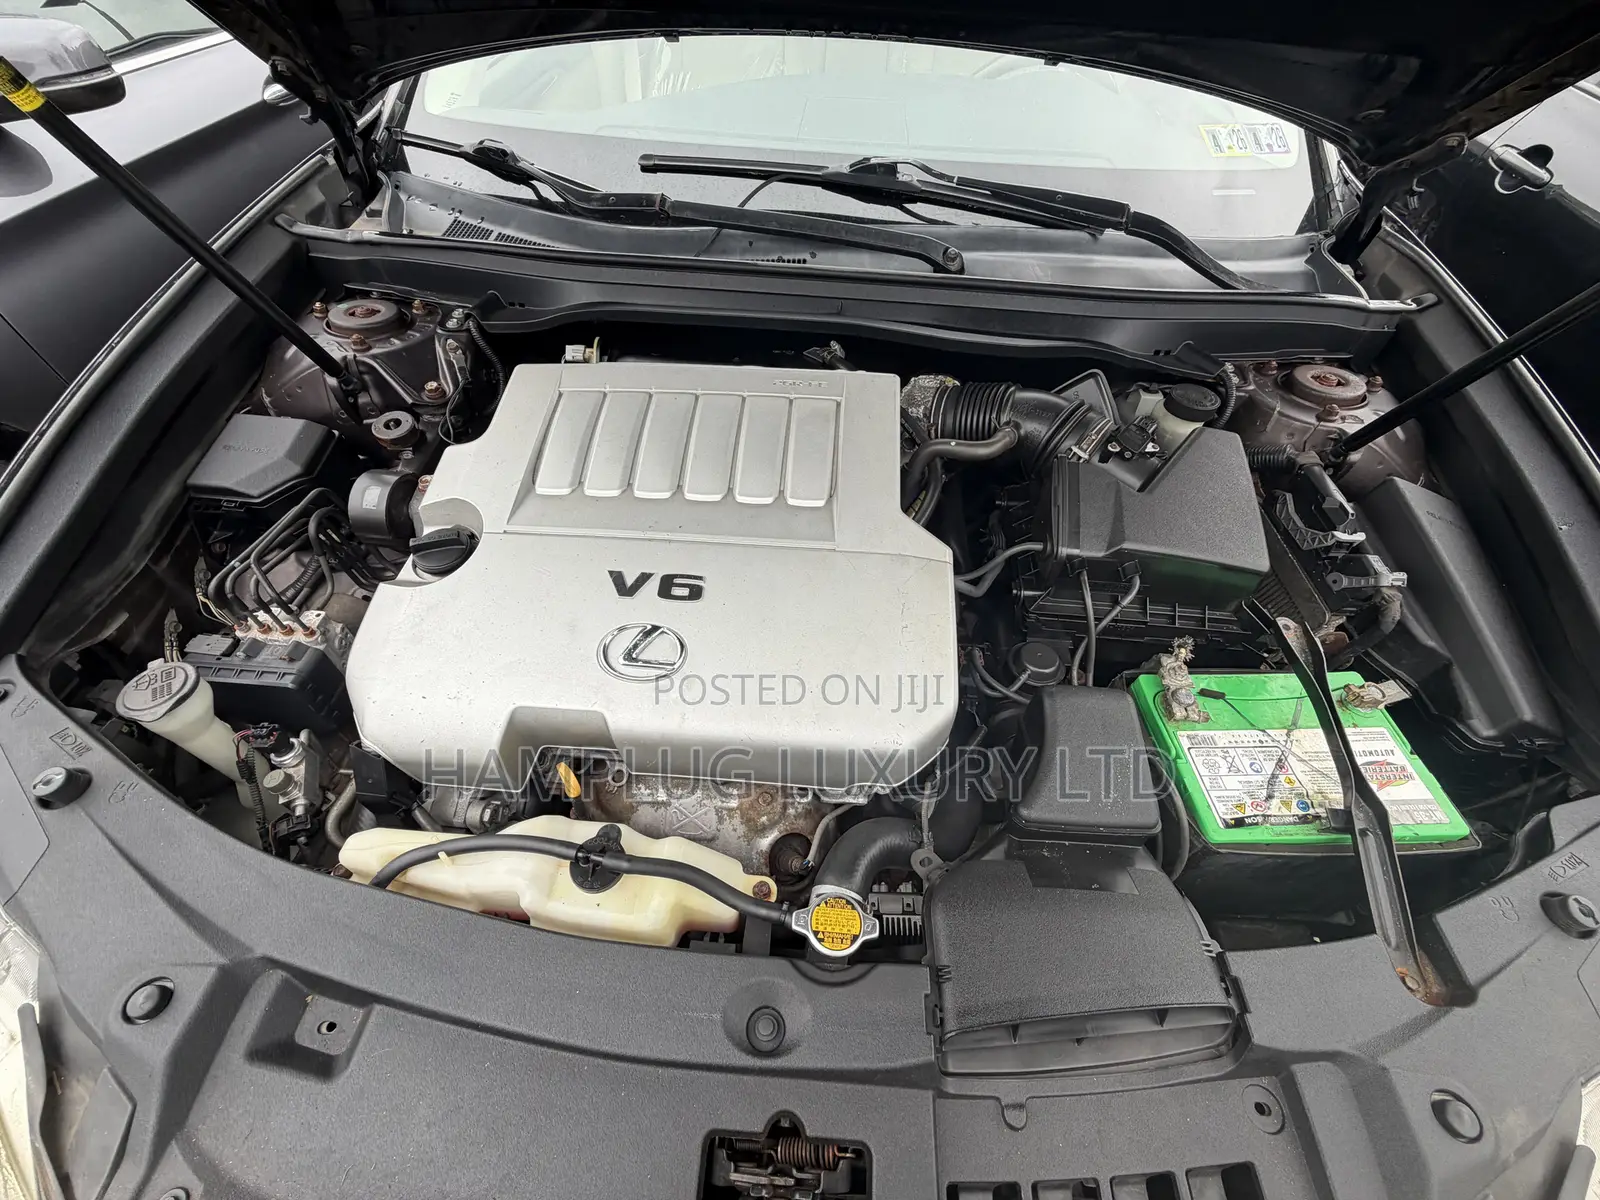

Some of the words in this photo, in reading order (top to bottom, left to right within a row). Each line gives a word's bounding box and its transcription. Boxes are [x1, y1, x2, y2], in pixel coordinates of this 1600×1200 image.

[608, 570, 706, 601] V6
[1353, 749, 1395, 758] AUTOMOTI
[1360, 765, 1406, 773] BATTERIE
[1364, 773, 1413, 781] INTERSTA
